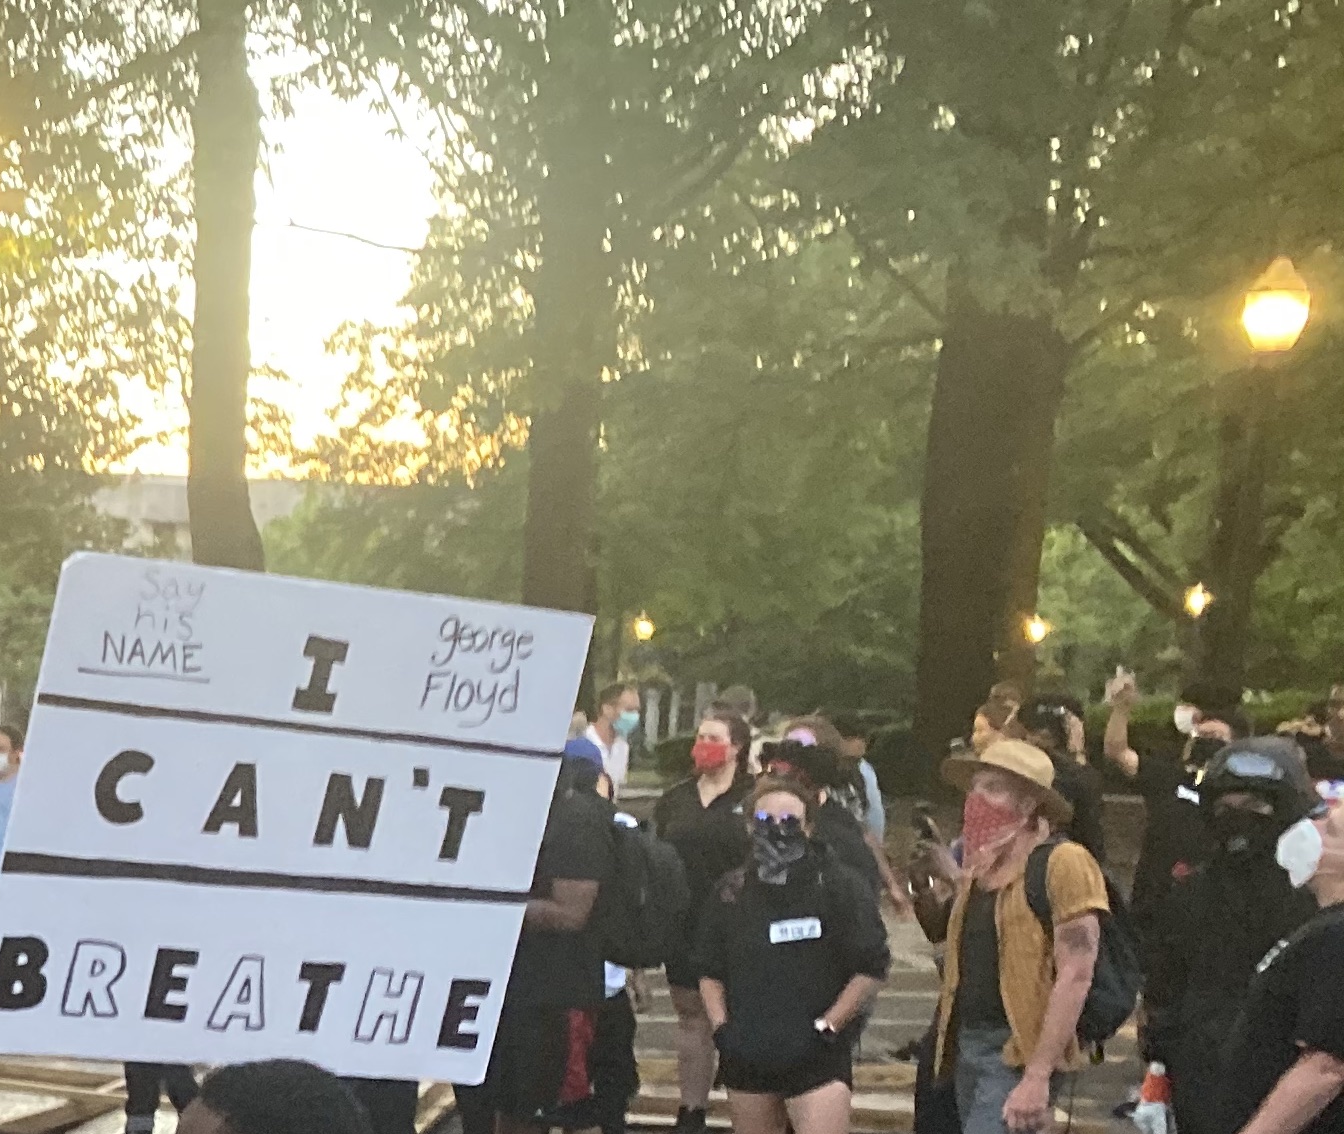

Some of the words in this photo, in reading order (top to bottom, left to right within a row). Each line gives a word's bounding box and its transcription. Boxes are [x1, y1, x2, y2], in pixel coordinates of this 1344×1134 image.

[141, 564, 206, 611] Say
[102, 629, 203, 674] NAME
[292, 634, 348, 714] I
[420, 666, 520, 728] Floyd
[94, 750, 485, 862] CAN'T
